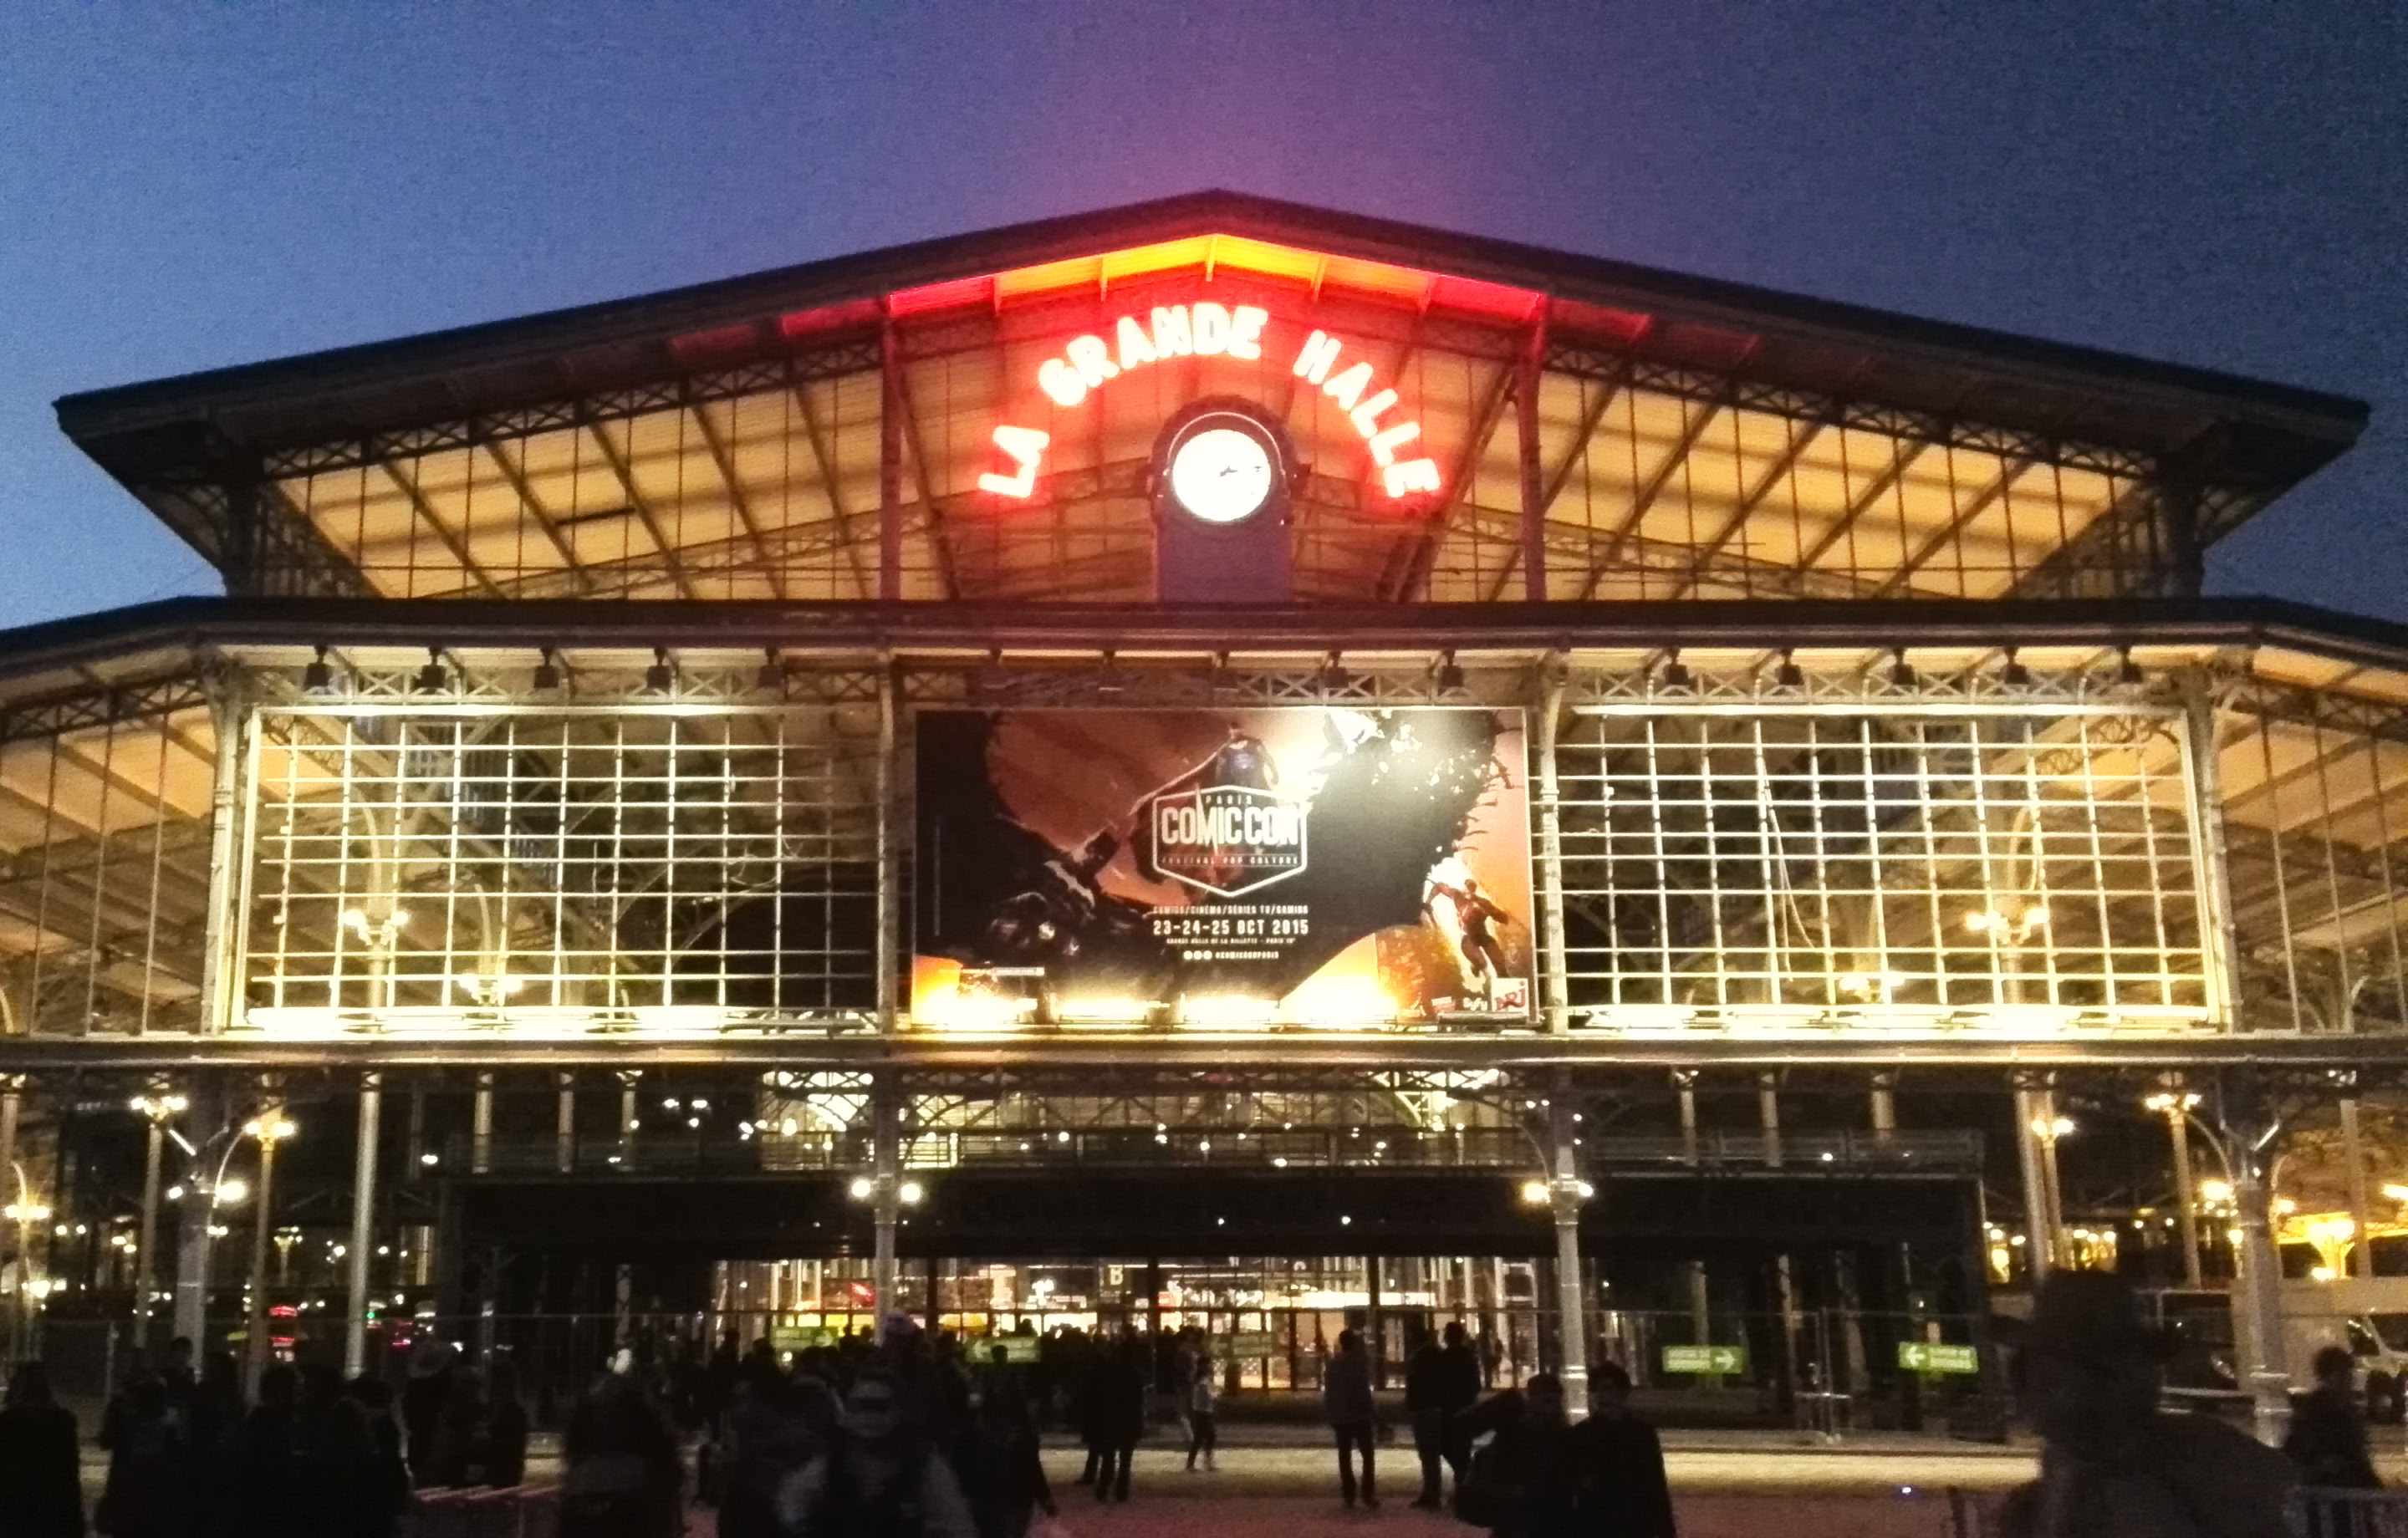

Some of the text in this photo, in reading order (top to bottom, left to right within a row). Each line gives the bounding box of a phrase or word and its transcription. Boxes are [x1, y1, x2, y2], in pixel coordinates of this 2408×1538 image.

[977, 302, 1441, 498] LA GRANDE HALLE
[1205, 795, 1252, 805] PARIS
[1161, 789, 1298, 851] COMIC CON
[1153, 919, 1309, 935] 23-24-25 OCT 2015
